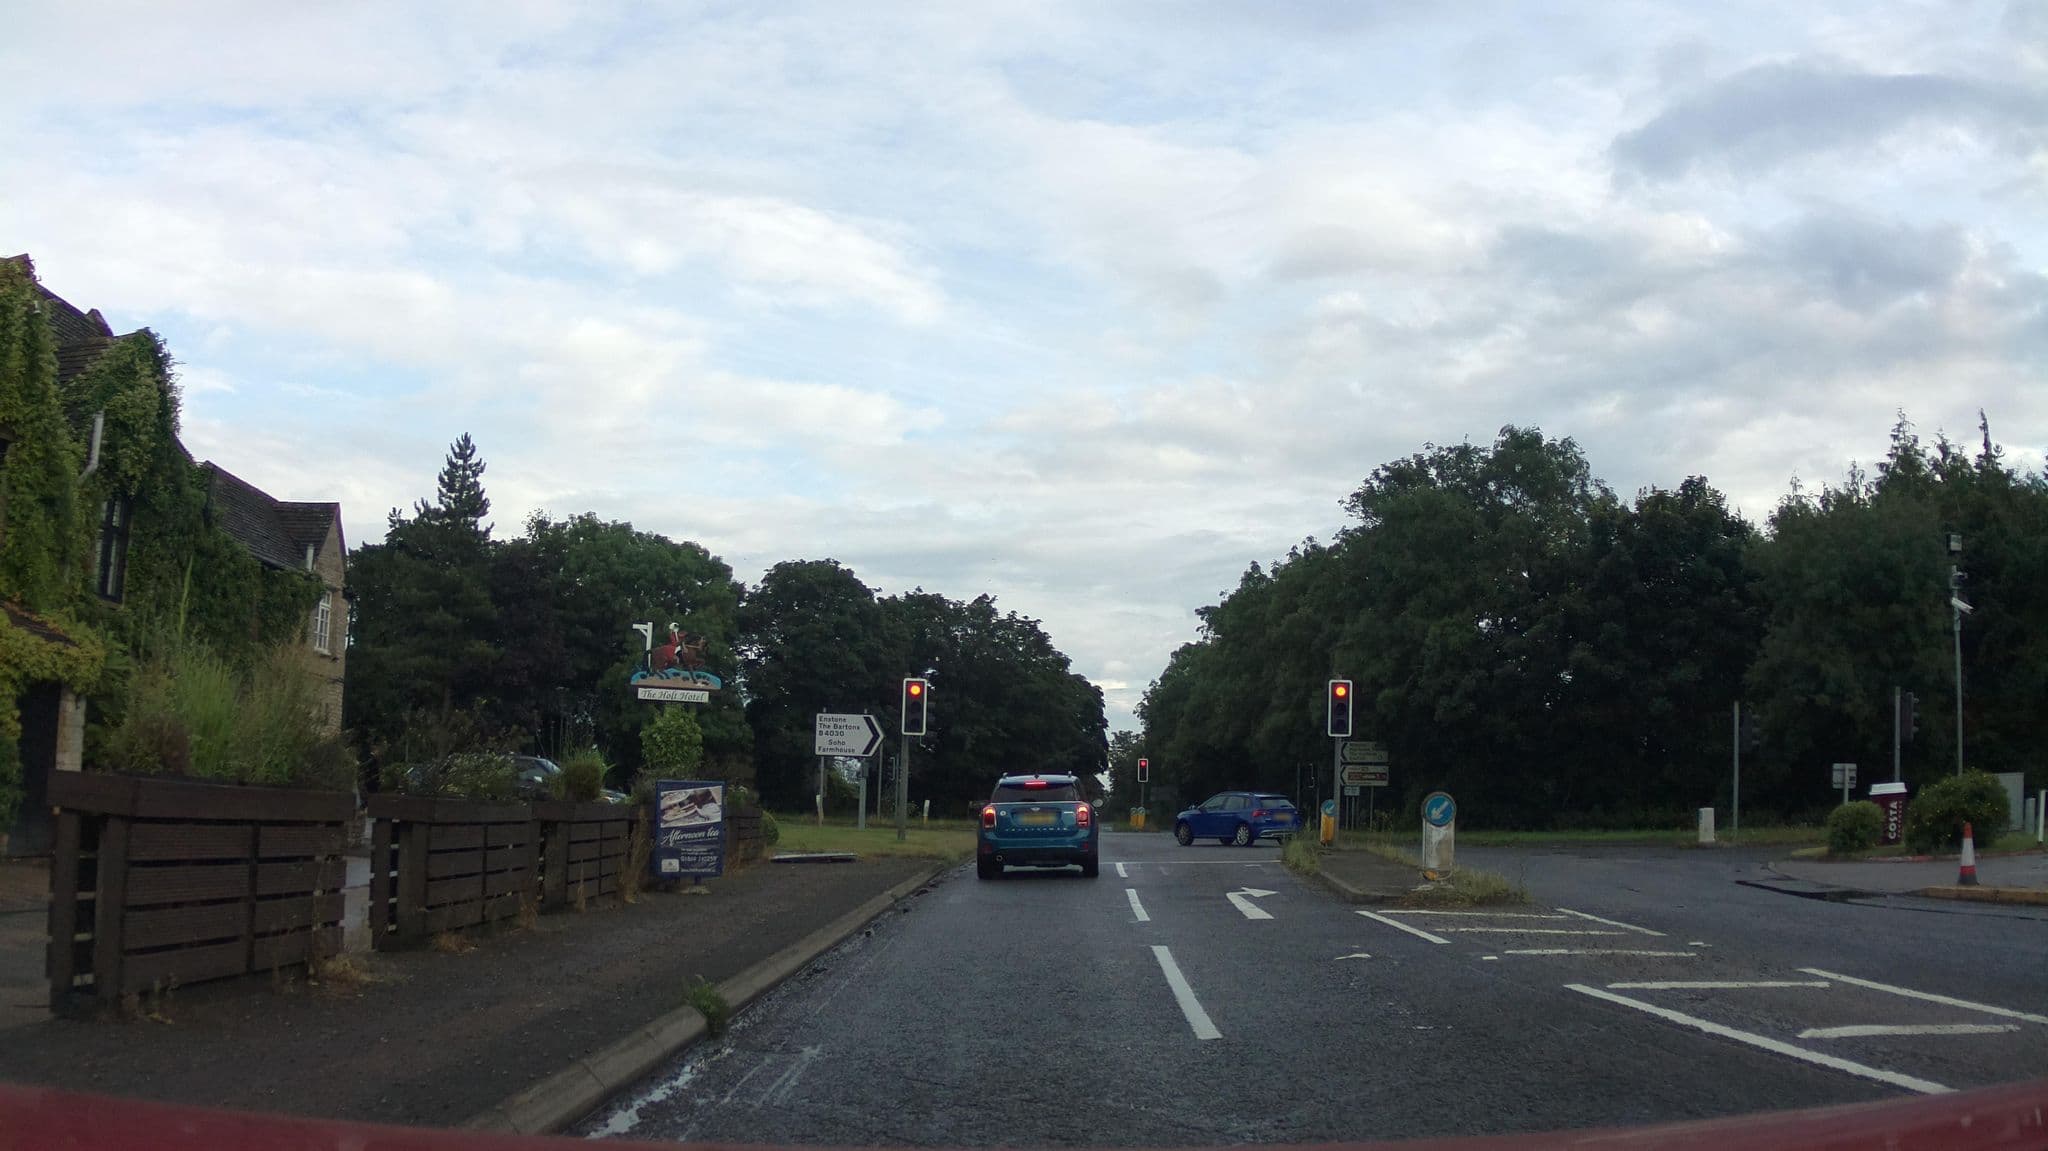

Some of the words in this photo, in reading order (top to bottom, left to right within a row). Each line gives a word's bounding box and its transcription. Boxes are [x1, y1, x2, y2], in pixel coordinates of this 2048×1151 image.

[642, 690, 656, 698] The
[660, 691, 677, 700] Holt
[680, 692, 704, 701] Hotel
[1888, 800, 1898, 840] COSTA
[660, 829, 706, 847] Afternoon
[707, 827, 719, 837] tea
